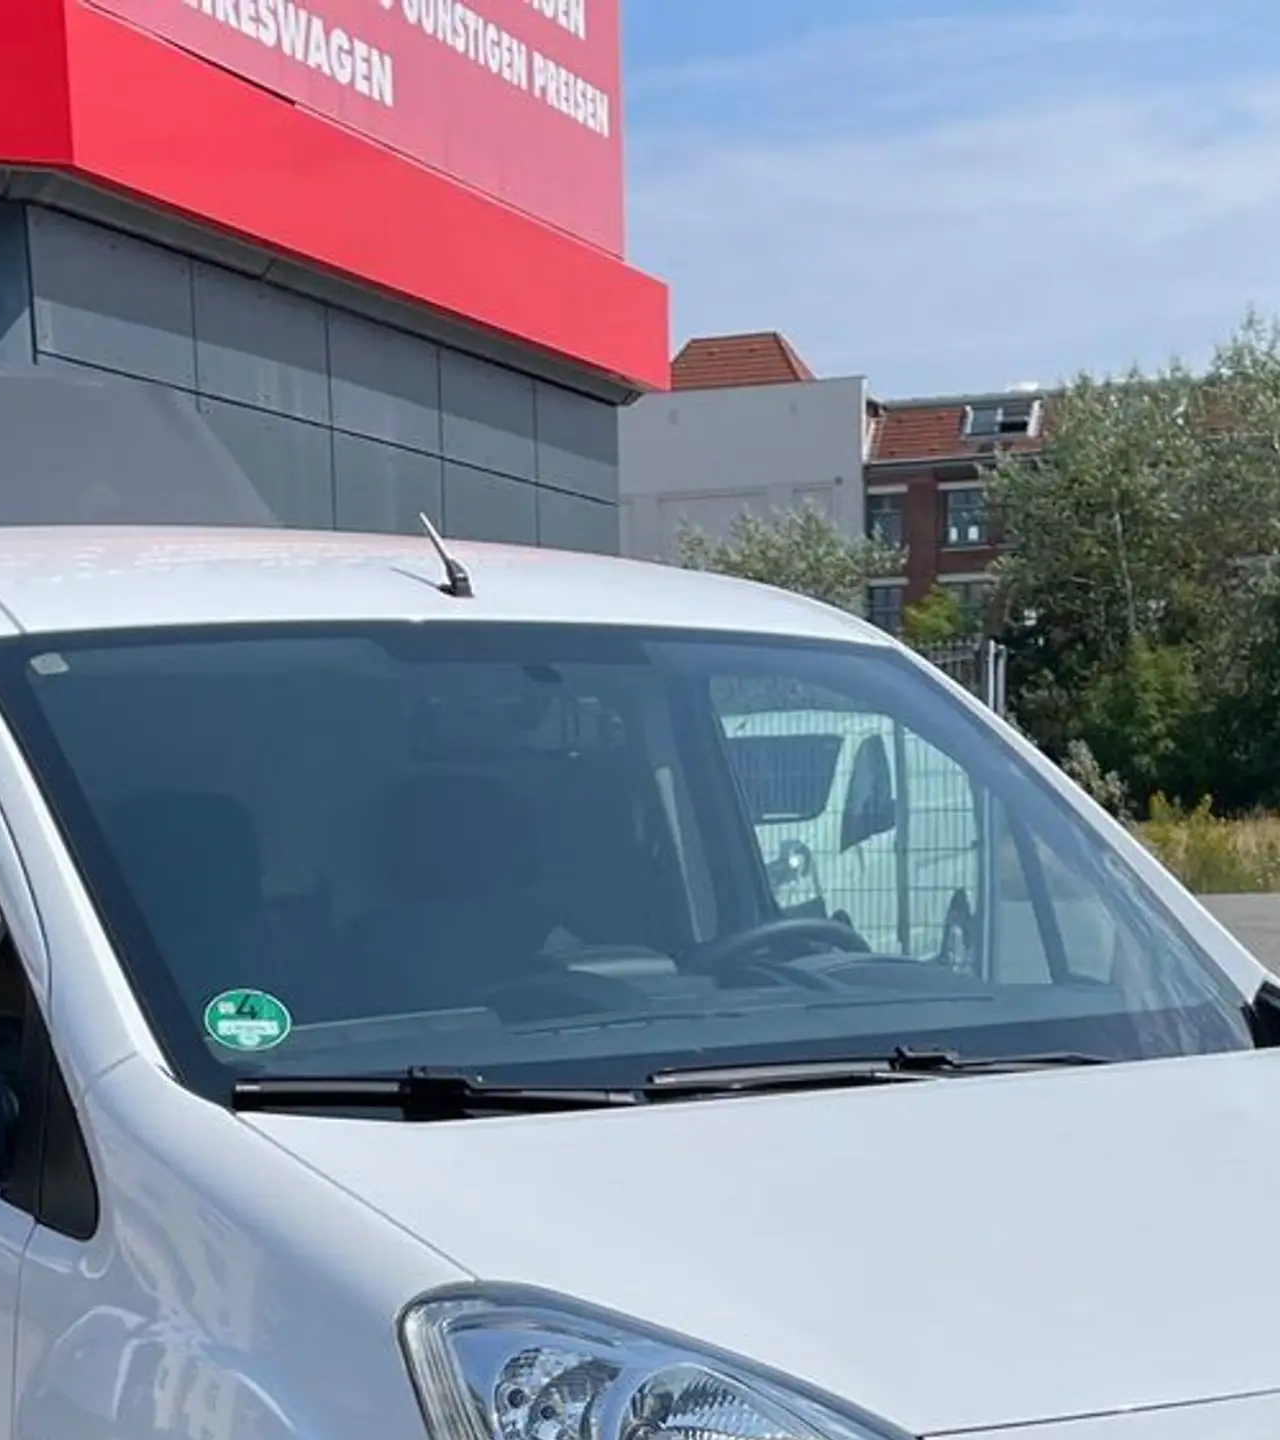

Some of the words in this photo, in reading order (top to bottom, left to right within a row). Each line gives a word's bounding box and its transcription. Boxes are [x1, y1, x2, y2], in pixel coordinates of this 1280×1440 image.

[183, 0, 393, 107] RESWAGEN
[531, 51, 609, 137] PREISEN
[236, 994, 258, 1020] 4
